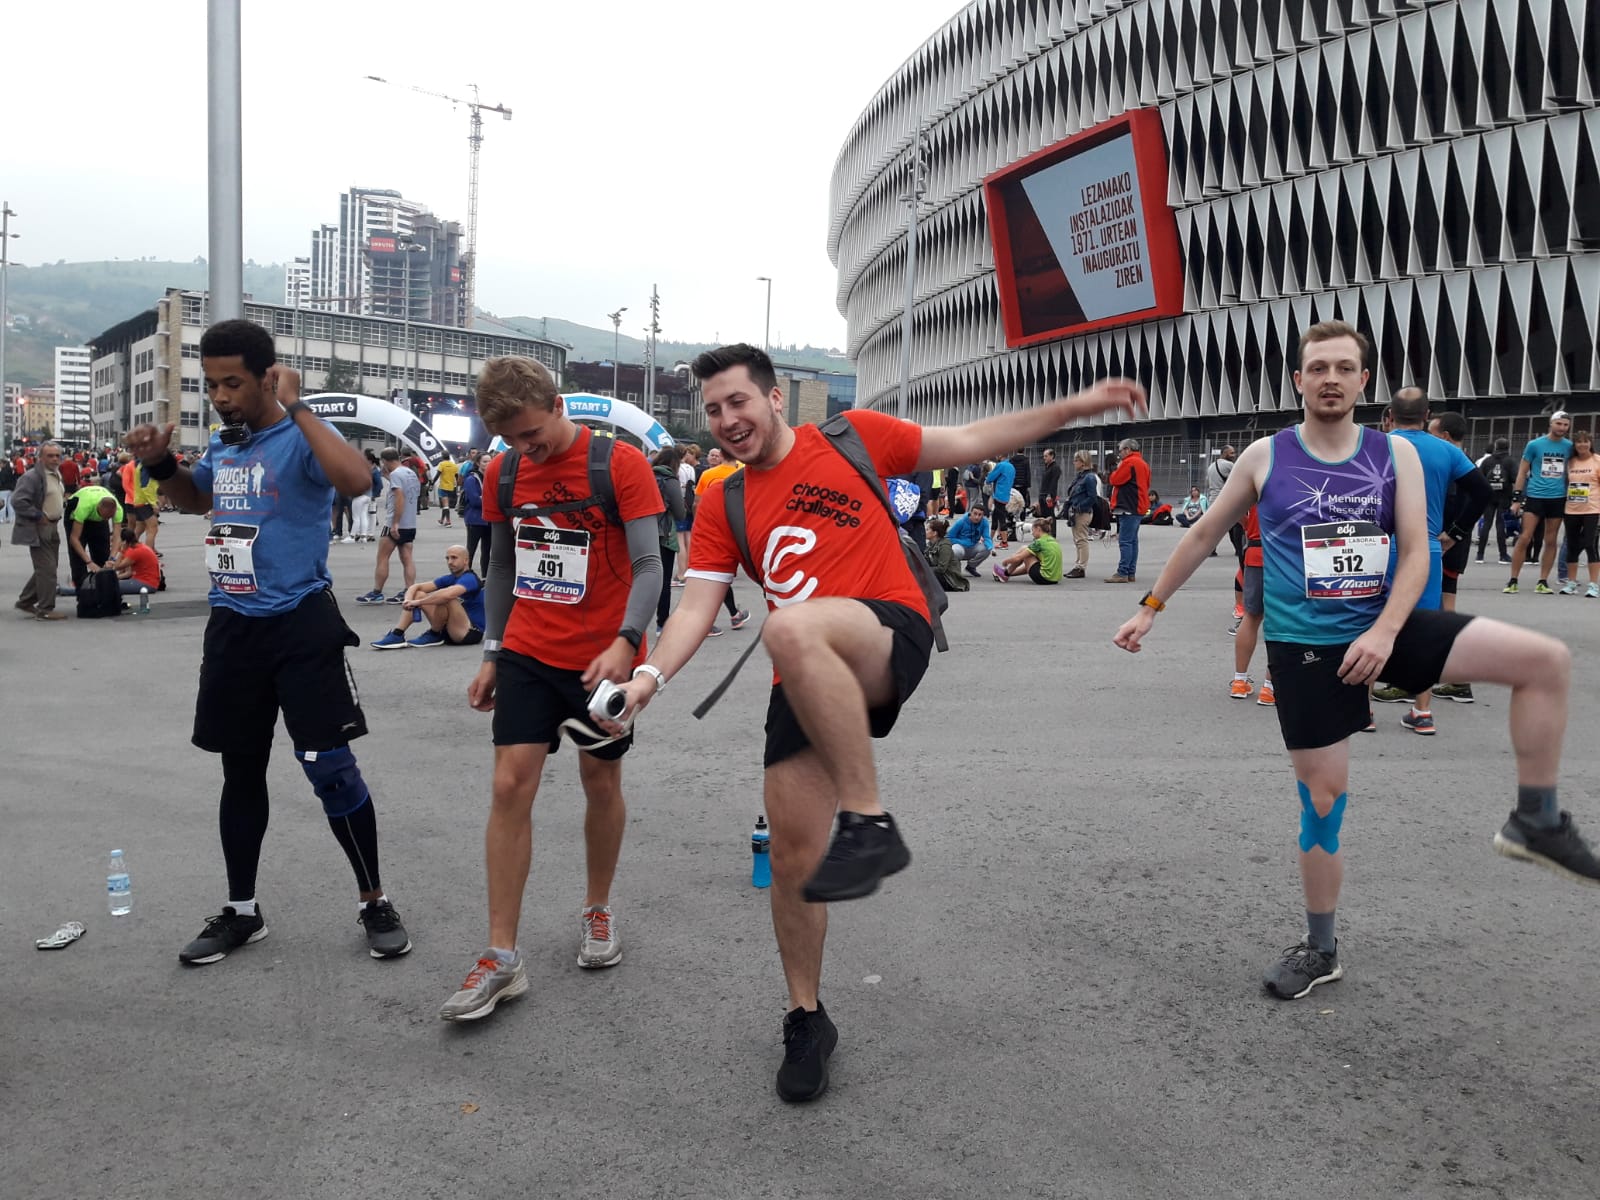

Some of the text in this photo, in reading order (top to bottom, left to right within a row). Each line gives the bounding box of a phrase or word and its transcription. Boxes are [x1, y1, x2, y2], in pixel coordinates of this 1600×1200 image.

[1081, 171, 1132, 207] LEZAMAKO
[1069, 194, 1135, 234] INSTALAZIOAK
[1070, 218, 1138, 256] 1971. URTEAN
[1082, 241, 1141, 275] INAUGURATU
[1115, 264, 1144, 289] ZIREN
[309, 401, 355, 414] START 6
[569, 401, 609, 412] START 5
[420, 431, 437, 451] 6
[657, 432, 674, 447] 5
[214, 467, 249, 484] TOUGH
[219, 498, 252, 511] FULL
[792, 482, 863, 512] choose a
[1328, 494, 1383, 506] Meningitis
[786, 497, 861, 529] challenge
[1329, 505, 1377, 515] Research
[543, 530, 560, 543] edp
[1336, 523, 1356, 536] edp
[217, 553, 235, 570] 391
[537, 559, 564, 578] 491
[1332, 554, 1364, 573] 512
